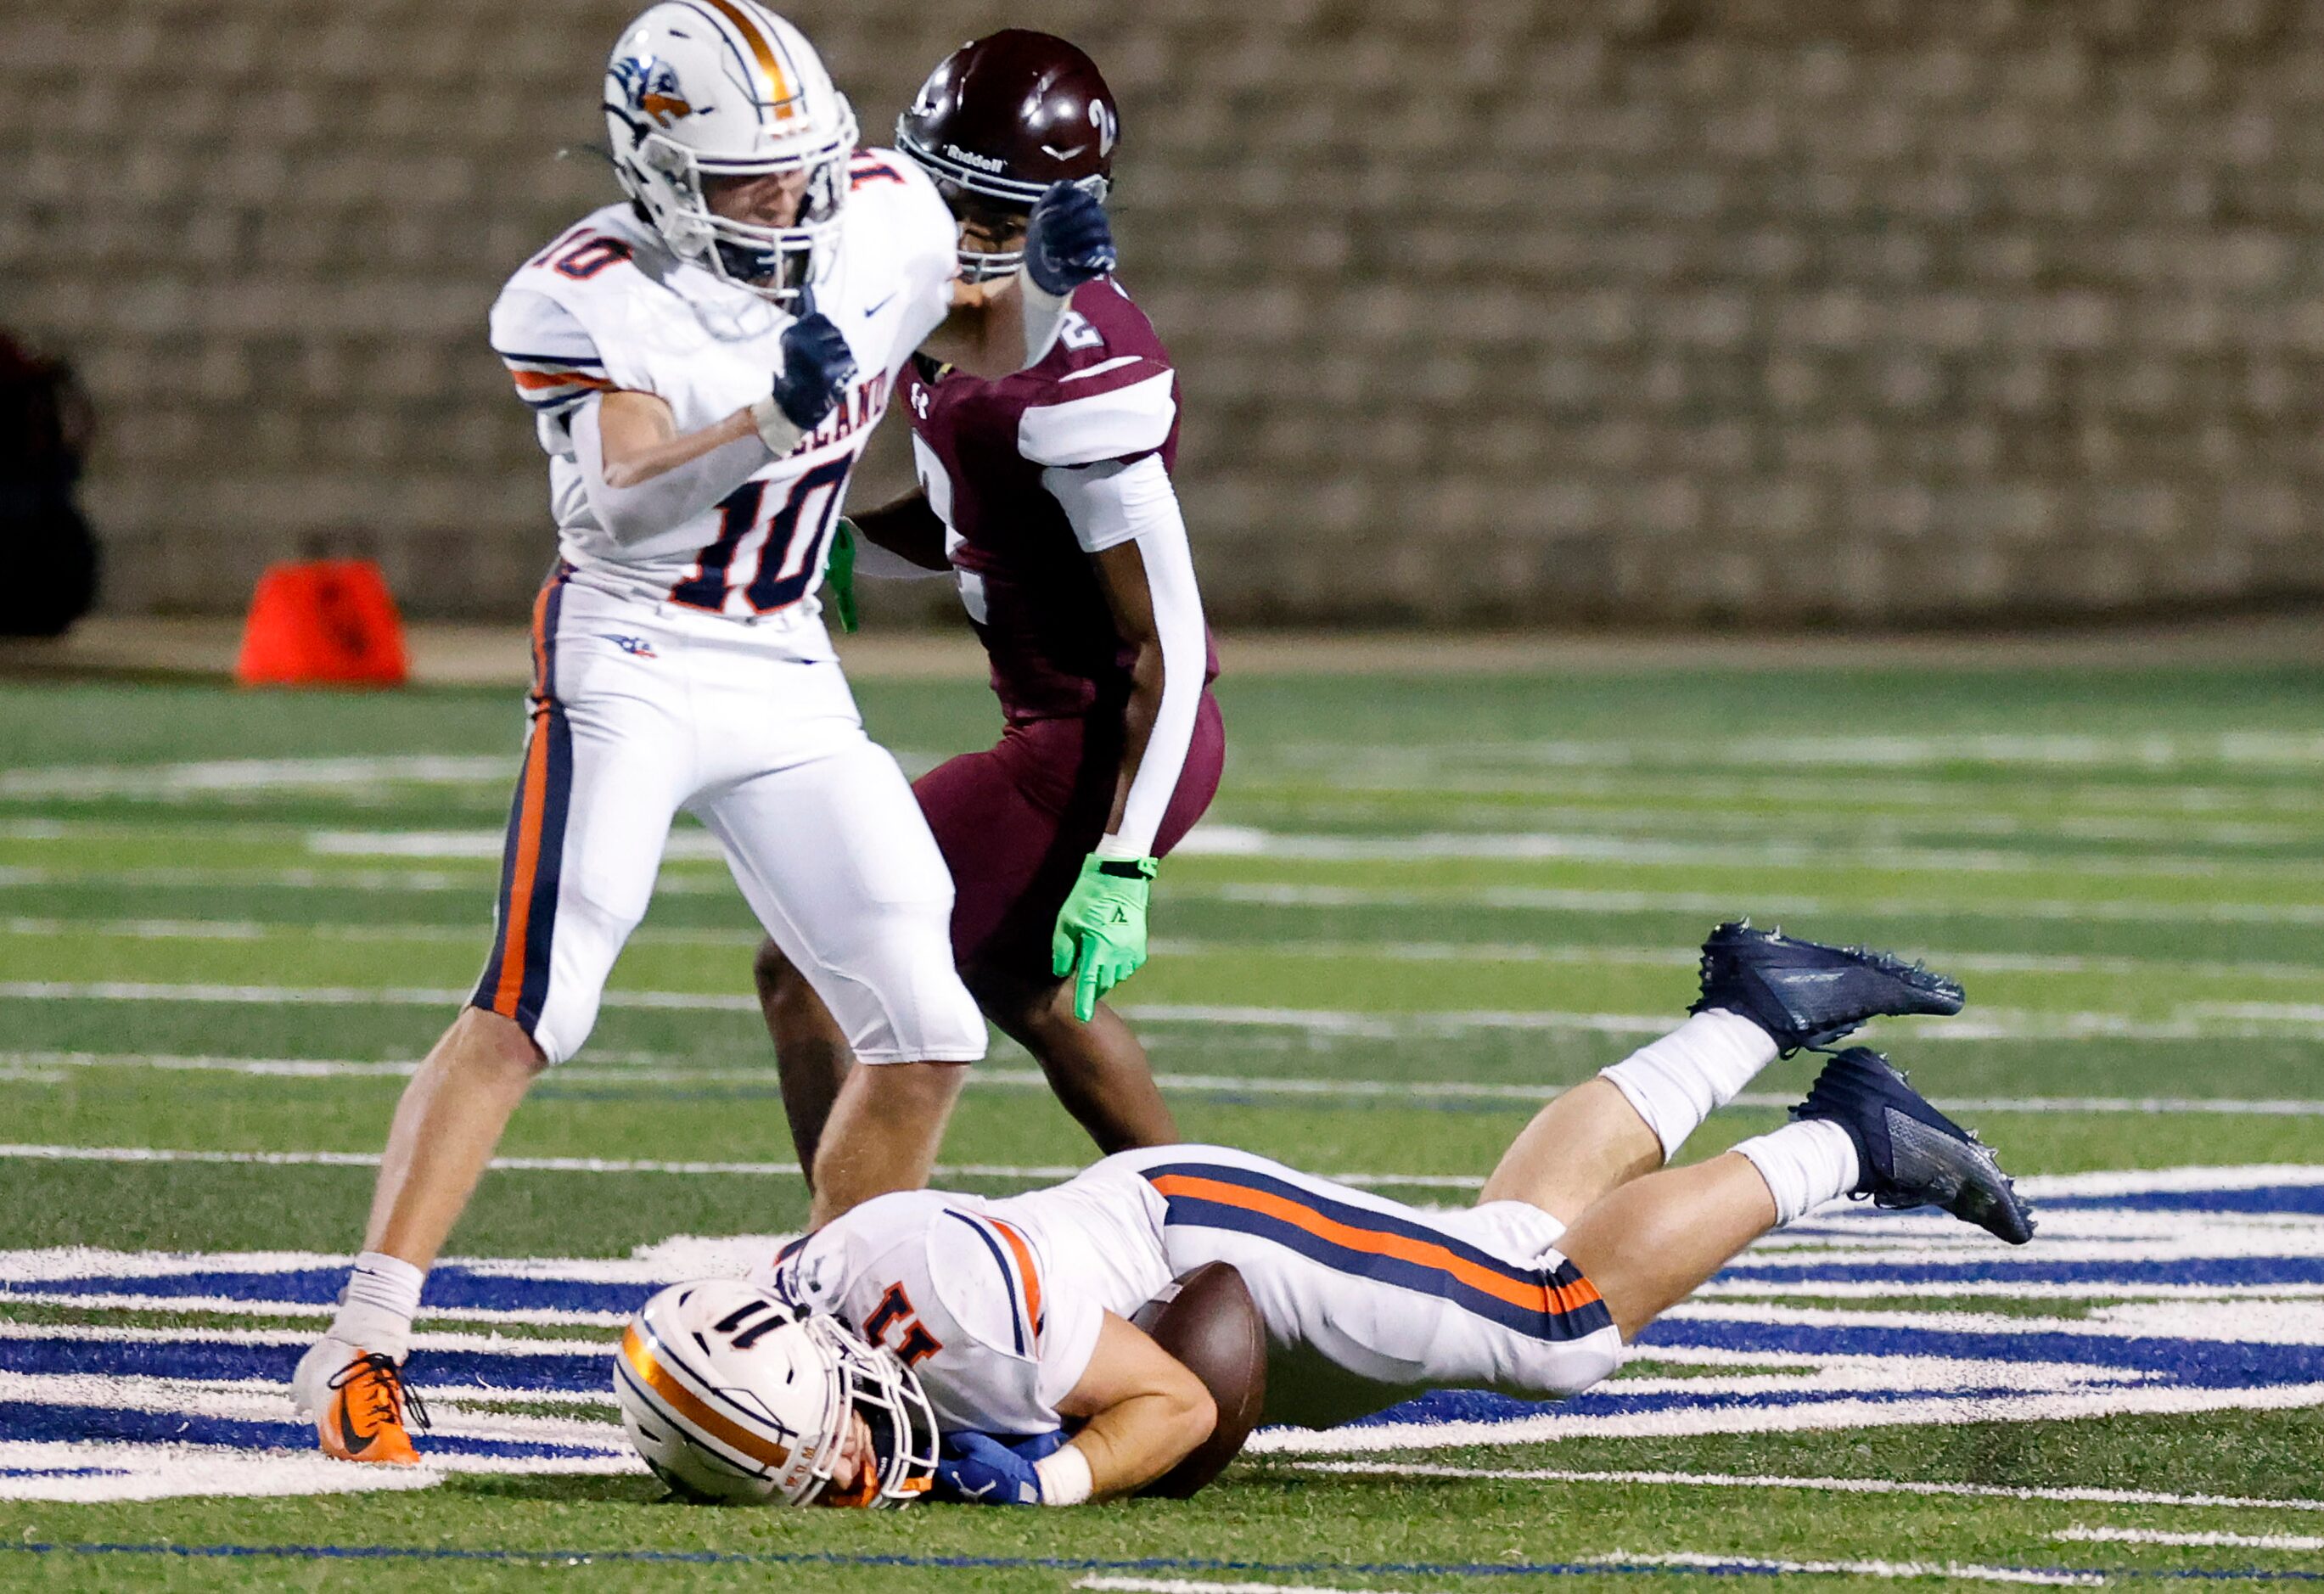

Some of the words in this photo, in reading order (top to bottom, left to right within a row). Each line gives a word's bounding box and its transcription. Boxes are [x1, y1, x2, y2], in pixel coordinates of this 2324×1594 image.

[946, 144, 1005, 173] Riddell
[531, 228, 633, 280] 10
[1058, 311, 1104, 351] 2
[667, 448, 854, 615] 10
[713, 1299, 789, 1351] 11
[862, 1280, 944, 1367] 11
